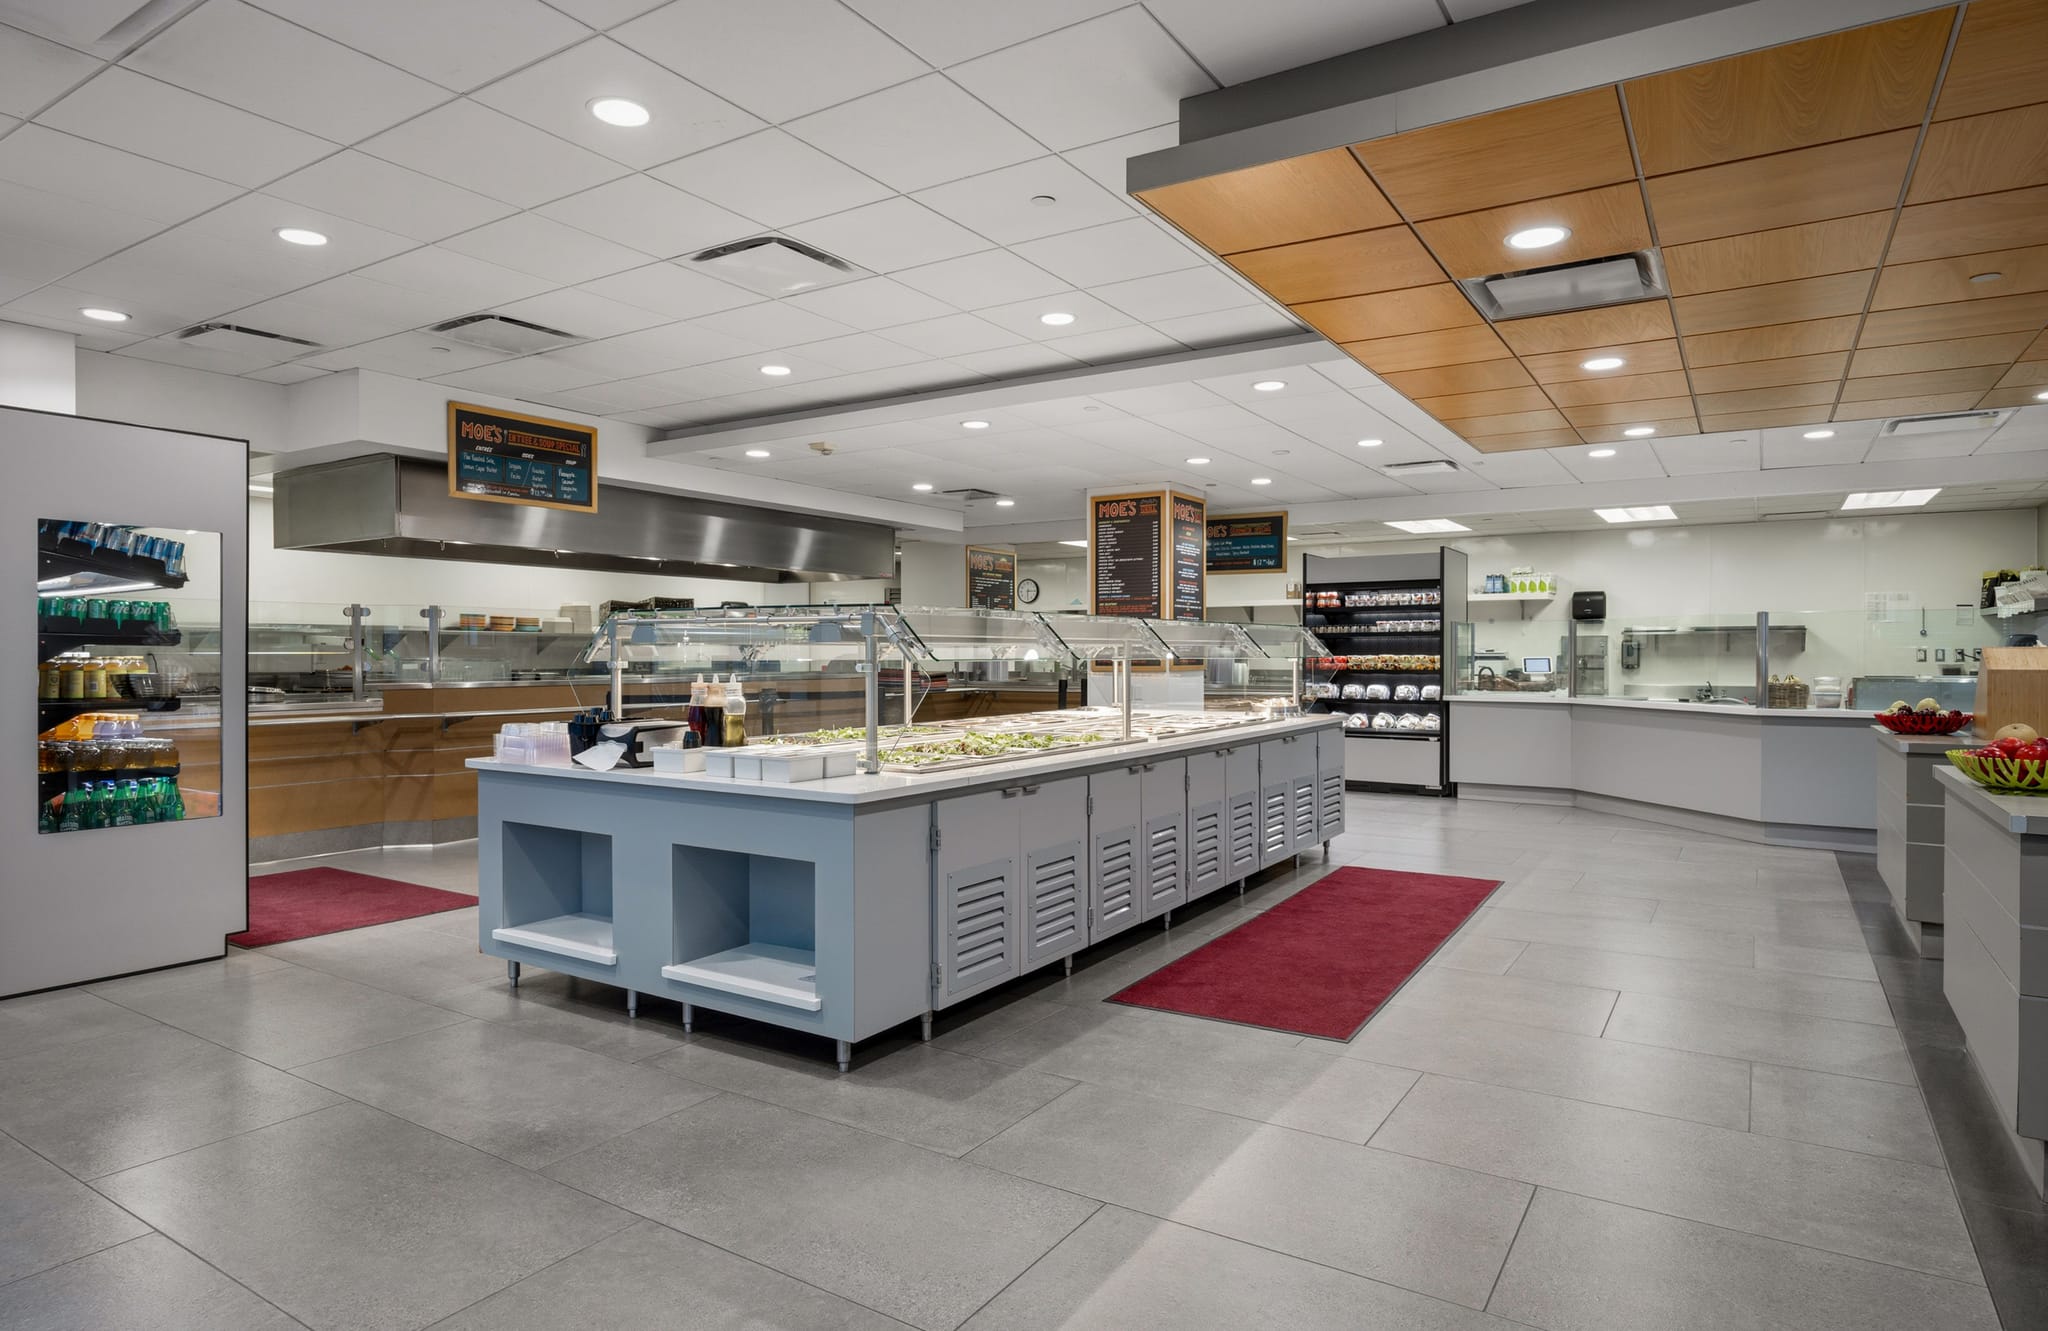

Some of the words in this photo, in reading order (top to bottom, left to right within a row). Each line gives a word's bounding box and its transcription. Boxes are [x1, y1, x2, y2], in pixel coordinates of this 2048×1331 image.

[461, 421, 503, 443] MOE'S
[555, 441, 580, 452] SPECIAL
[1098, 500, 1137, 518] MOE'S
[1174, 503, 1195, 523] MOE'S
[1206, 525, 1228, 538] OE'S
[970, 554, 993, 571] MOE'S
